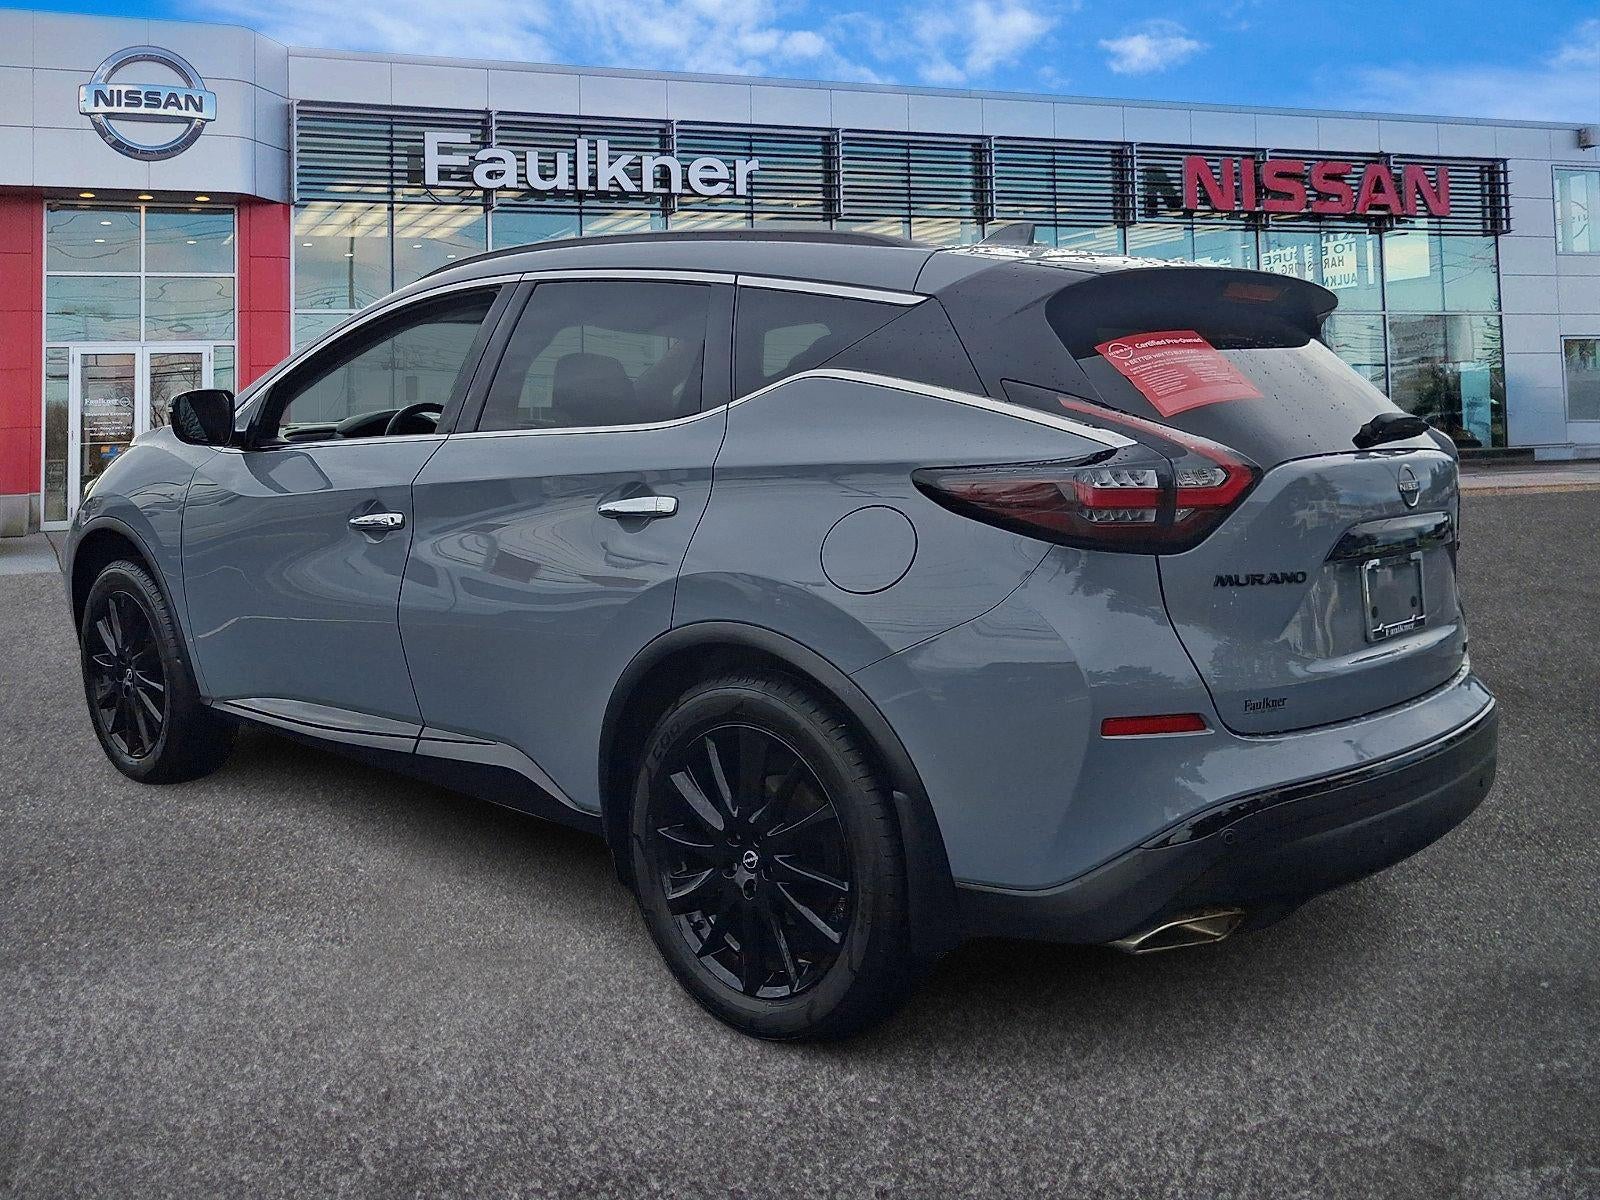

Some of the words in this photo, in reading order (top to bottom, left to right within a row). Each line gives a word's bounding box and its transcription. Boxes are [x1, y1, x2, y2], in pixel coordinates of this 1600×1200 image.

[94, 89, 204, 113] NISSAN
[423, 131, 760, 197] Faulkner
[1182, 155, 1451, 216] NISSAN
[1134, 339, 1165, 349] Certified
[1213, 571, 1307, 587] MURANO
[1385, 622, 1415, 637] Faulkner
[1244, 697, 1288, 711] Faulkner
